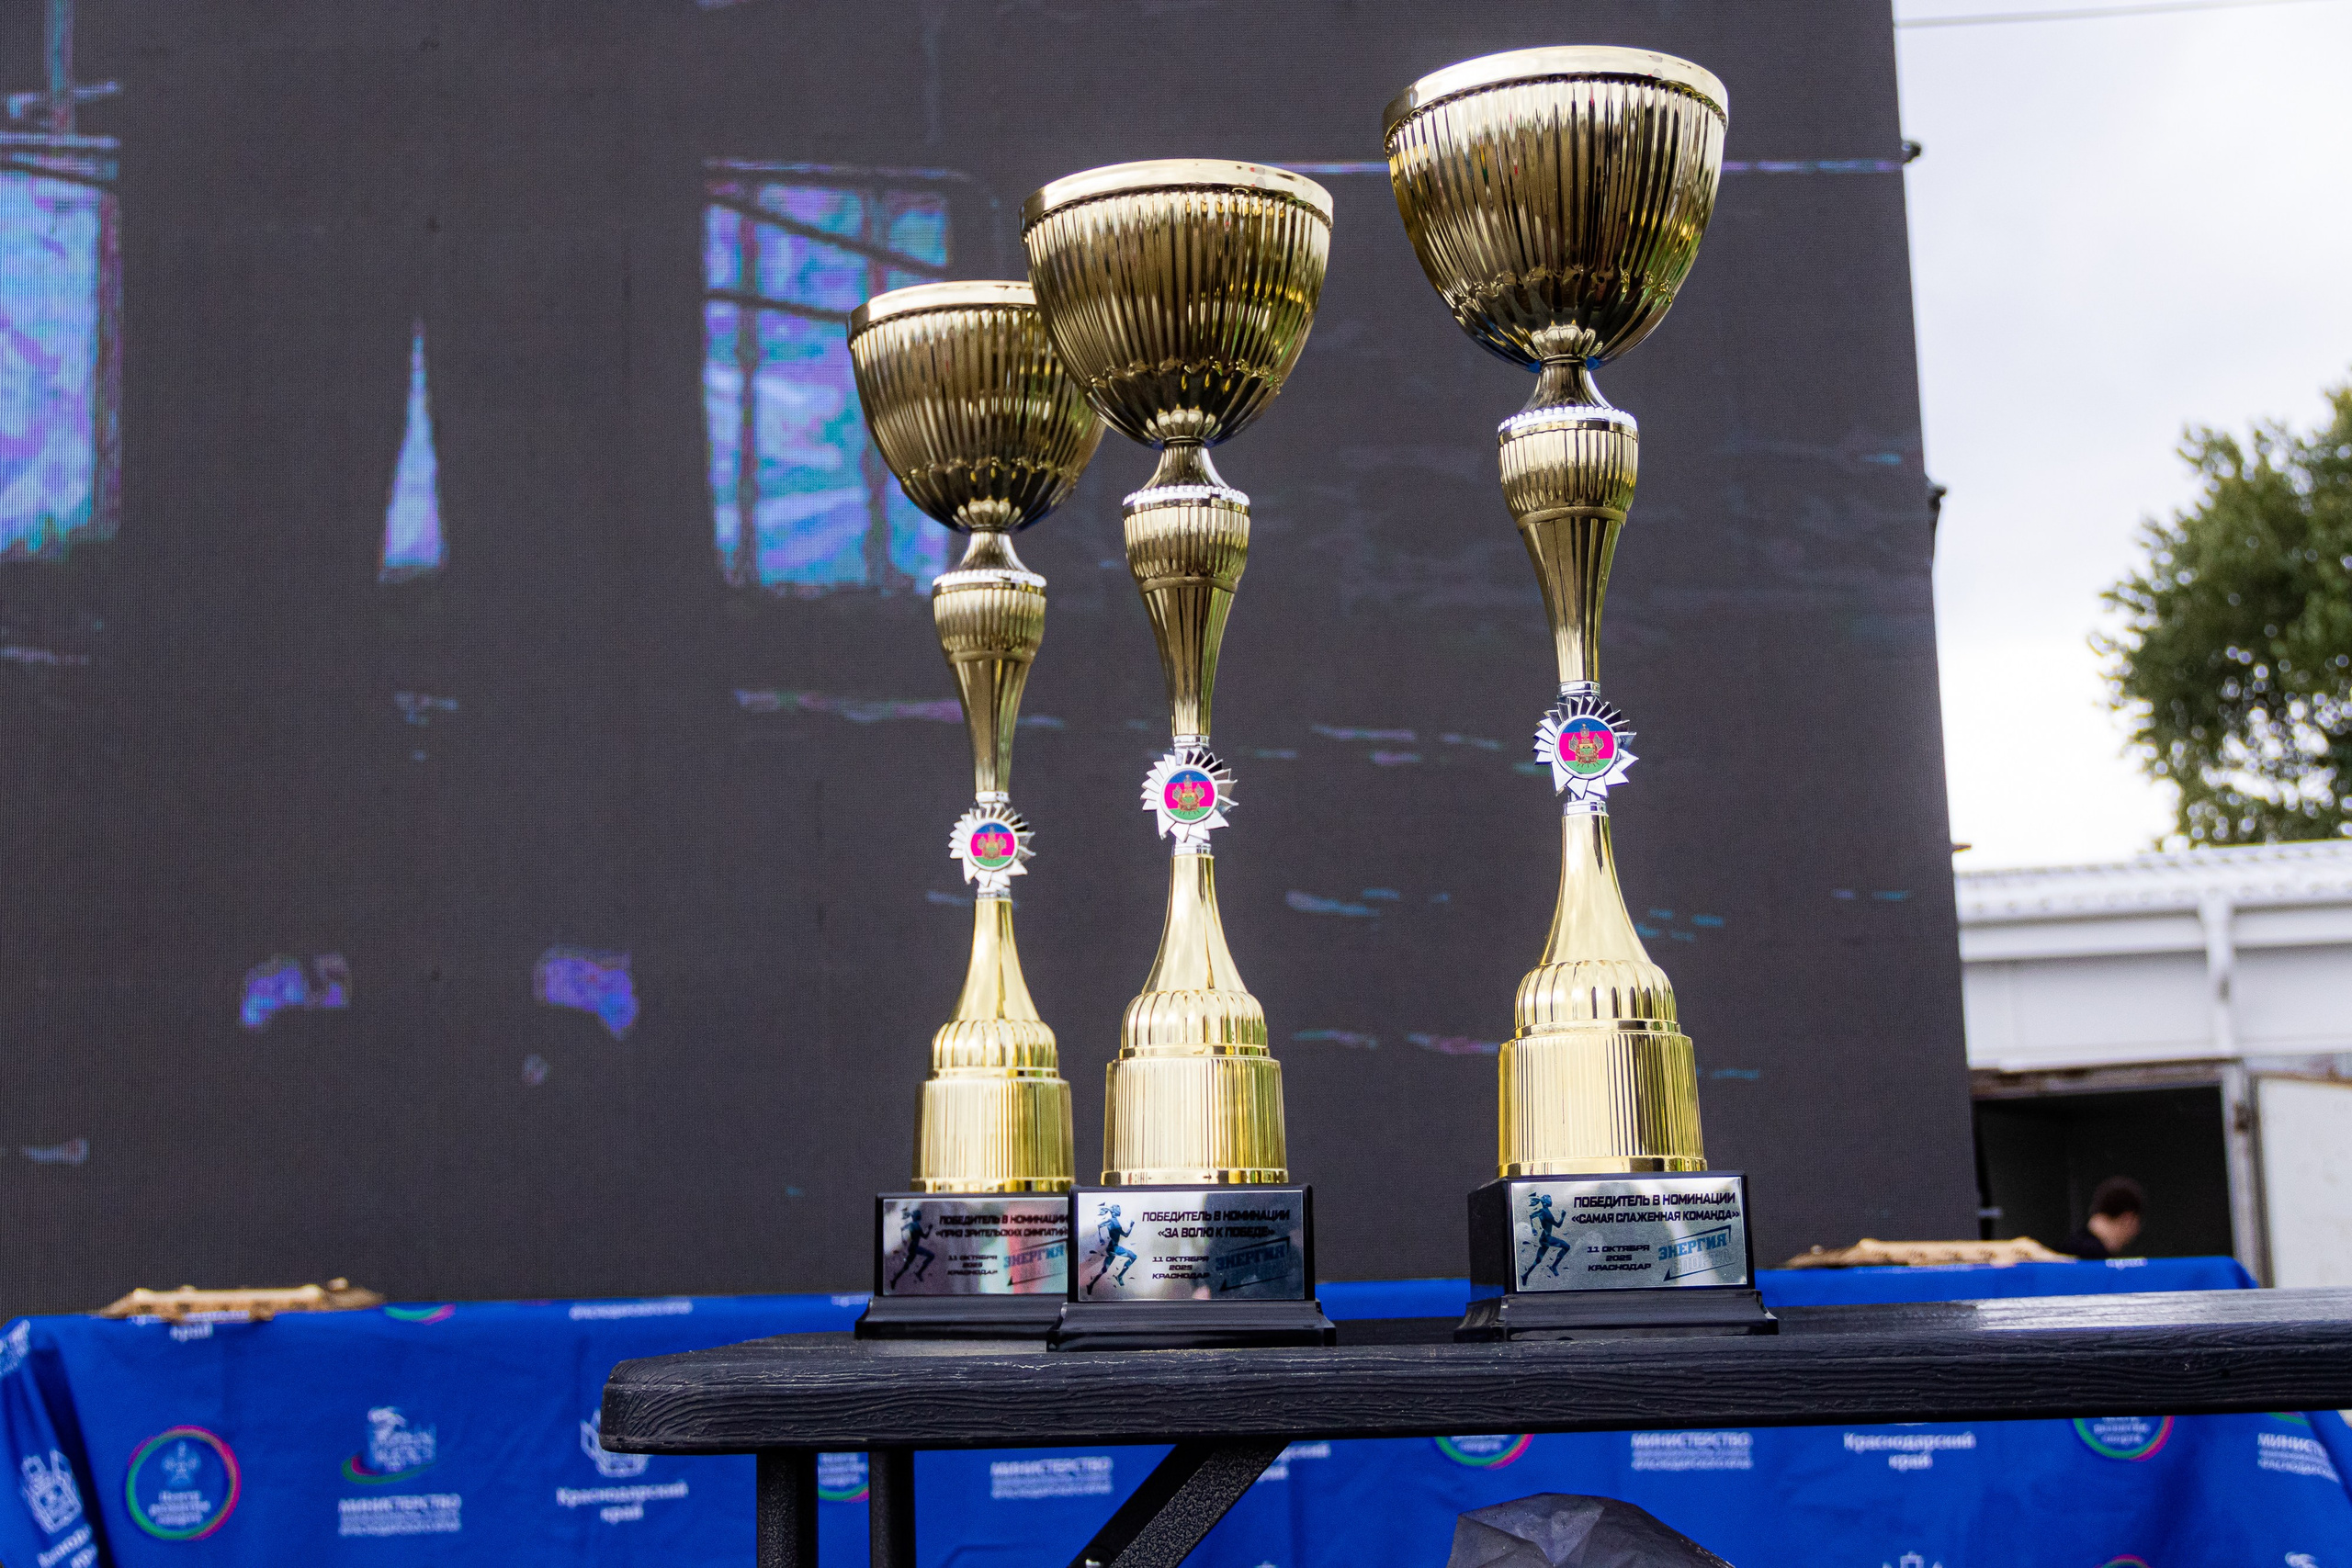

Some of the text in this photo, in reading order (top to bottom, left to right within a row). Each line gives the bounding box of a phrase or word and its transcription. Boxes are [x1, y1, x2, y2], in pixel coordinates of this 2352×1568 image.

[1574, 1192, 1736, 1208] ПОБЕДИТЕЛЬ В НОМИНАЦИИ
[940, 1215, 1000, 1225] ПОБЕДИТЕЛЬ
[1001, 1215, 1009, 1224] В
[1142, 1210, 1290, 1223] ПОБЕДИТЕЛЬ В НОМИНАЦИИ
[1572, 1210, 1740, 1224] «САМАЯ СЛАЖЕННАЯ КОМАНДА»
[965, 1228, 1022, 1237] ЗРИТЕЛЬСКИХ
[1158, 1226, 1275, 1238] «ЗА ВОЛЮ К ПОБЕДЕ»
[1602, 1245, 1650, 1253] ОКТЯБРЯ
[1658, 1233, 1727, 1261] ЭНЕРГИЯ
[1003, 1245, 1064, 1269] ЭНЕРГИЯ
[1216, 1245, 1286, 1270] ЭНЕРГИЯ
[1588, 1263, 1652, 1272] КРАСНОДАР
[1844, 1431, 1976, 1453] Краснодарский
[1889, 1451, 1933, 1472] край
